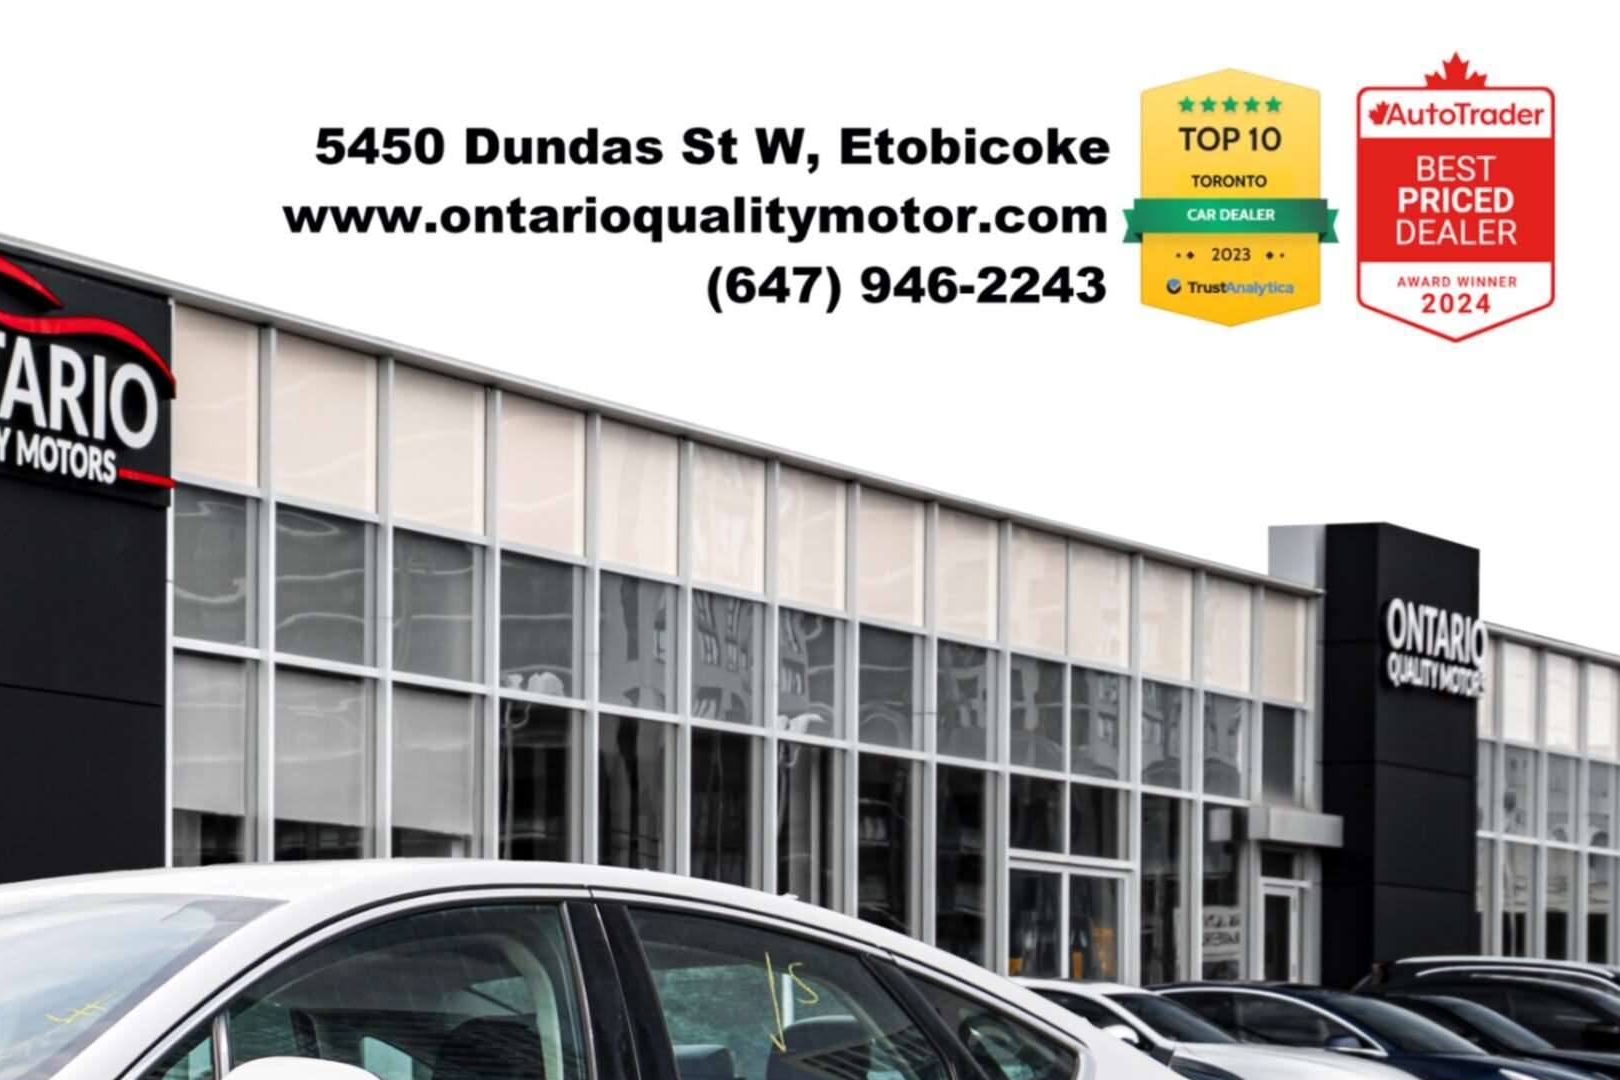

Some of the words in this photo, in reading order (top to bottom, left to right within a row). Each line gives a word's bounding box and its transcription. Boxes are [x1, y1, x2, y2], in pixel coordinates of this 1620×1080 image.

[16, 430, 118, 485] MOTORS
[1387, 597, 1488, 669] ONTARIO
[1387, 651, 1439, 689] QUALITY
